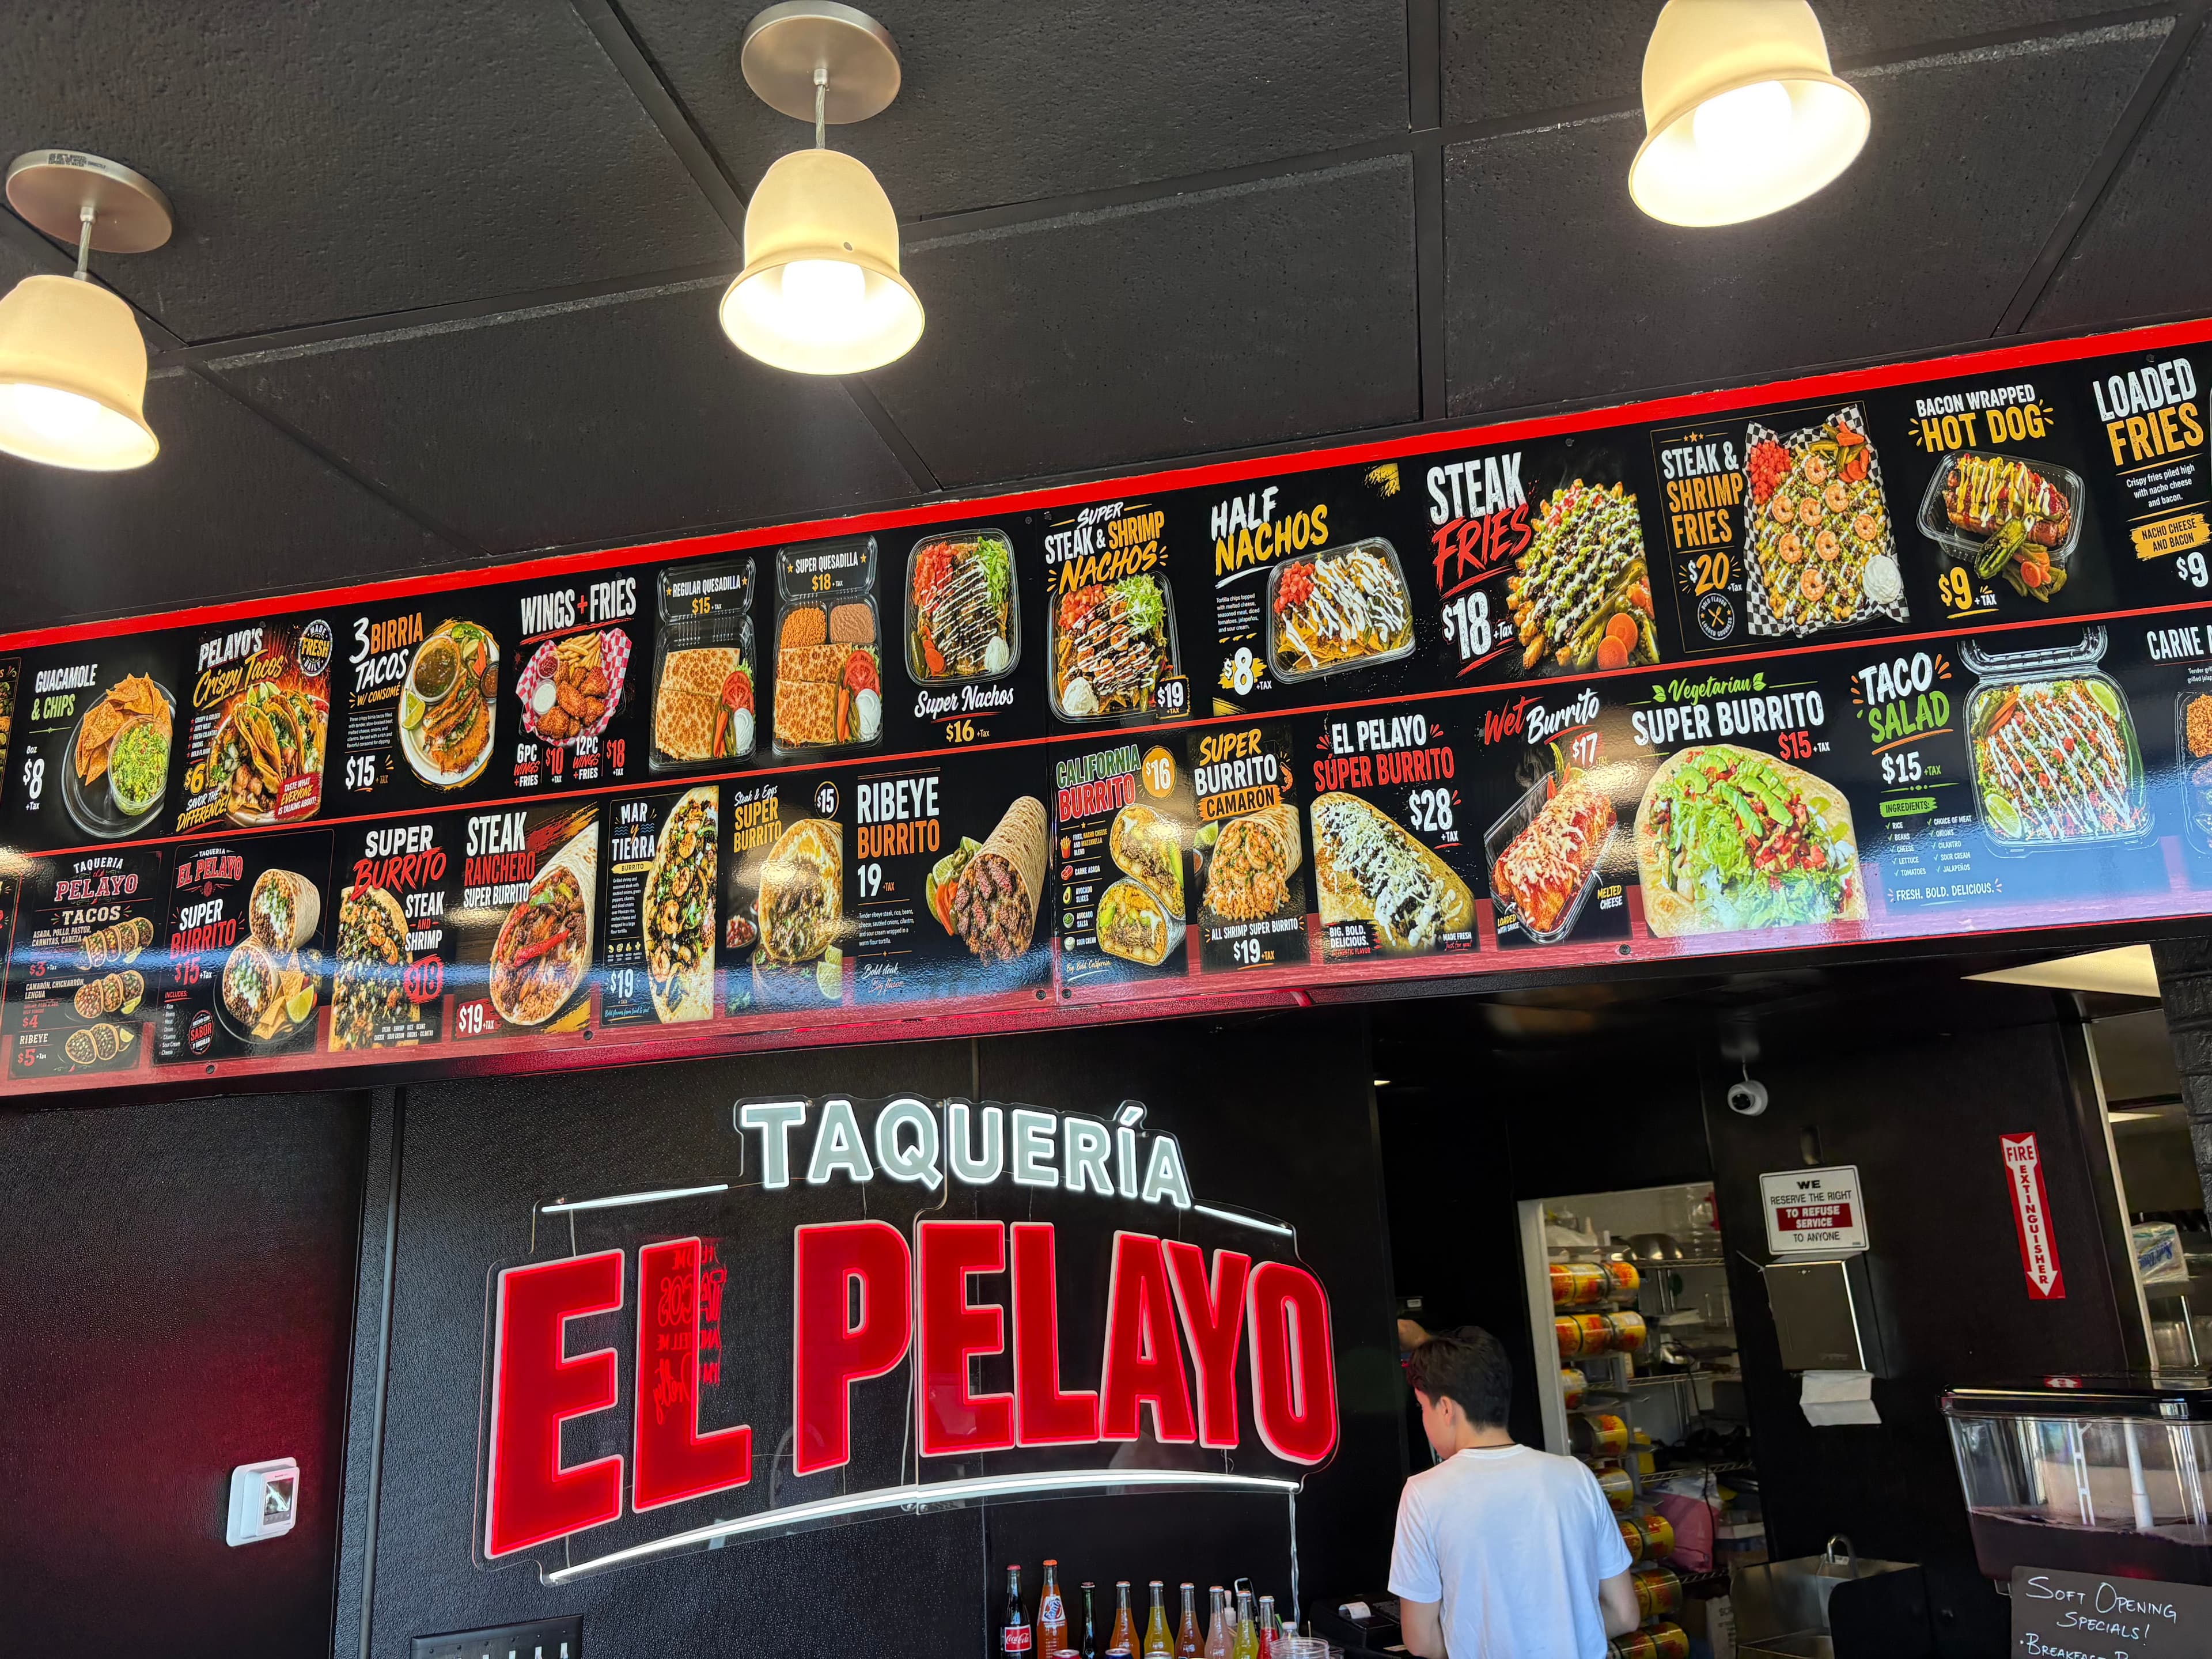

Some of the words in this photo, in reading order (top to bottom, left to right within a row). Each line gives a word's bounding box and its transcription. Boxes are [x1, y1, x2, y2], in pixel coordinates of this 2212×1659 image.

[1916, 394, 1964, 418] BACON
[1966, 384, 2036, 410] WRAPPED
[2093, 358, 2196, 422] LOADED
[1921, 412, 1976, 453] HOT
[1986, 403, 2046, 444] DOG
[2107, 402, 2203, 466] FRIES
[1661, 444, 1721, 479] STEAK
[1722, 441, 1739, 470] &
[1427, 452, 1527, 525] STEAK
[2126, 476, 2147, 488] Crispy
[2147, 472, 2163, 483] fries
[2164, 468, 2180, 480] piled
[2180, 464, 2195, 475] high
[2134, 488, 2148, 499] with
[2149, 483, 2168, 495] nacho
[2170, 478, 2192, 489] cheese
[1666, 472, 1743, 513] SHRIMP
[2148, 498, 2160, 507] and
[2161, 493, 2183, 504] bacon.
[1077, 502, 1124, 529] SUPER
[1211, 486, 1279, 541] HALF
[1672, 508, 1732, 548] FRIES
[1044, 527, 1094, 565] STEAK
[1096, 529, 1106, 549] &
[1108, 511, 1165, 550] SHRIMP
[1215, 504, 1328, 577] NACHOS
[2142, 525, 2167, 540] NACHO
[2168, 518, 2196, 534] CHEESE
[2153, 541, 2168, 552] AND
[2170, 533, 2195, 548] BACON
[796, 559, 817, 574] SUPER
[819, 551, 858, 571] QUESADILLA
[1431, 502, 1532, 595] FRIES
[1059, 540, 1158, 594] NACHOS
[673, 581, 701, 597] REGULAR
[702, 575, 741, 593] QUESADILLA
[1938, 566, 1972, 610] $9
[521, 589, 575, 635] WINGS
[590, 577, 636, 623] FRIES
[349, 617, 370, 664] 3
[370, 612, 423, 655] BIRRIA
[1442, 591, 1492, 660] $18
[198, 627, 263, 672] PELAYO'S
[301, 638, 330, 658] FRESH
[2147, 626, 2205, 660] CARNE
[35, 664, 97, 694] GUACAMOLE
[193, 666, 243, 708] Crispy
[244, 649, 285, 691] Tacos
[355, 648, 410, 692] TACOS
[1858, 652, 1933, 705] TACO
[357, 694, 369, 706] W/
[368, 681, 401, 703] CONSOMÉ
[914, 690, 959, 719] Super
[961, 684, 1014, 711] Nachos
[1157, 681, 1184, 708] $19
[1668, 676, 1751, 706] Vegetarian
[31, 698, 40, 720] &
[43, 694, 75, 719] CHIPS
[1484, 696, 1544, 745] Wet
[1527, 687, 1600, 745] Burrito
[1631, 704, 1713, 746] SUPER
[1716, 690, 1824, 737] BURRITO
[1868, 691, 1950, 743] SALAD
[946, 719, 974, 743] $16
[1332, 722, 1354, 755] EL
[1357, 714, 1426, 752] PELAYO
[1778, 730, 1812, 760] $15
[26, 745, 37, 754] 8oz
[573, 753, 600, 768] WINGS
[1199, 728, 1262, 766] SUPER
[514, 760, 540, 775] WINGS
[1056, 744, 1142, 789] CALIFORNIA
[1194, 753, 1277, 796] BURRITO
[1313, 753, 1373, 792] SÚPER
[1376, 746, 1455, 786] BURRITO
[1881, 751, 1922, 784] $15
[284, 781, 297, 791] TASTE
[298, 777, 310, 787] WHAT
[734, 790, 753, 806] Steak
[754, 788, 760, 800] &
[762, 784, 778, 800] Eggs
[1058, 774, 1136, 823] BURRITO
[621, 802, 648, 825] MAR
[735, 797, 778, 830] SUPER
[857, 777, 940, 824] RIBEYE
[1206, 785, 1275, 817] CAMARÓN
[1409, 787, 1453, 832] $28
[1886, 801, 1930, 813] INGREDIENTS:
[466, 812, 527, 857] STEAK
[1934, 817, 1950, 825] CHOICE
[365, 825, 433, 858] SUPER
[612, 835, 655, 861] TIERRA
[734, 820, 782, 853] BURRITO
[858, 819, 940, 859] BURRITO
[1895, 833, 1910, 841] BEANS
[1938, 840, 1961, 849] CILANTRO
[199, 848, 225, 857] TAQUERIA
[1899, 857, 1919, 865] LETTUCE
[176, 863, 193, 888] EL
[195, 856, 243, 881] PELAYO
[350, 847, 446, 902] BURRITO
[464, 851, 536, 888] RANCHERO
[622, 863, 644, 872] BURRITO
[858, 863, 881, 897] 19
[1900, 868, 1926, 876] TOMATOES
[1943, 863, 1971, 873] JALAPEÑOS
[54, 873, 138, 902] PELAYO
[463, 886, 491, 908] SUPER
[493, 882, 530, 905] BURRITO
[1597, 885, 1622, 899] MELTED
[1896, 888, 1923, 902] FRESH.
[1926, 886, 1949, 899] BOLD.
[1952, 882, 1994, 896] DELICIOUS.
[62, 906, 121, 925] TACOS
[179, 899, 224, 931] SUPER
[405, 892, 445, 919] STEAK
[1600, 896, 1623, 910] CHEESE
[417, 919, 431, 930] AND
[1211, 929, 1222, 941] ALL
[1224, 925, 1248, 939] SHRIMP
[1249, 921, 1270, 935] SUPER
[1271, 918, 1298, 933] BURRITO
[1329, 926, 1344, 937] BIG.
[1345, 924, 1366, 935] BOLD.
[1498, 914, 1516, 927] LOADED
[170, 918, 237, 960] BURRITO
[405, 929, 442, 952] SHRIMP
[1330, 936, 1369, 948] DELICIOUS.
[1442, 933, 1456, 941] MADE
[1457, 931, 1472, 940] FRESH
[29, 961, 46, 976] $3
[25, 991, 45, 999] LENGUA
[23, 1015, 38, 1028] $4
[459, 1003, 483, 1033] $19
[20, 1033, 48, 1045] RIBEYE
[18, 1049, 36, 1066] $5
[740, 1100, 1192, 1209] TAQUERÍA
[2006, 1145, 2035, 1162] FIRE
[1770, 1194, 1806, 1205] RESERVE
[1809, 1192, 1824, 1202] THE
[1828, 1190, 1852, 1200] RIGHT
[1797, 1180, 1821, 1190] WE
[1786, 1209, 1798, 1218] TO
[1802, 1206, 1840, 1217] REFUSE
[1796, 1218, 1832, 1229] SERVICE
[2020, 1165, 2049, 1285] EXTINGUISHER
[1793, 1233, 1804, 1243] TO
[1807, 1232, 1840, 1242] ANYONE
[484, 1236, 752, 1559] EL
[793, 1219, 1338, 1477] PELAYO
[2026, 1633, 2106, 1659] BREAKFA
